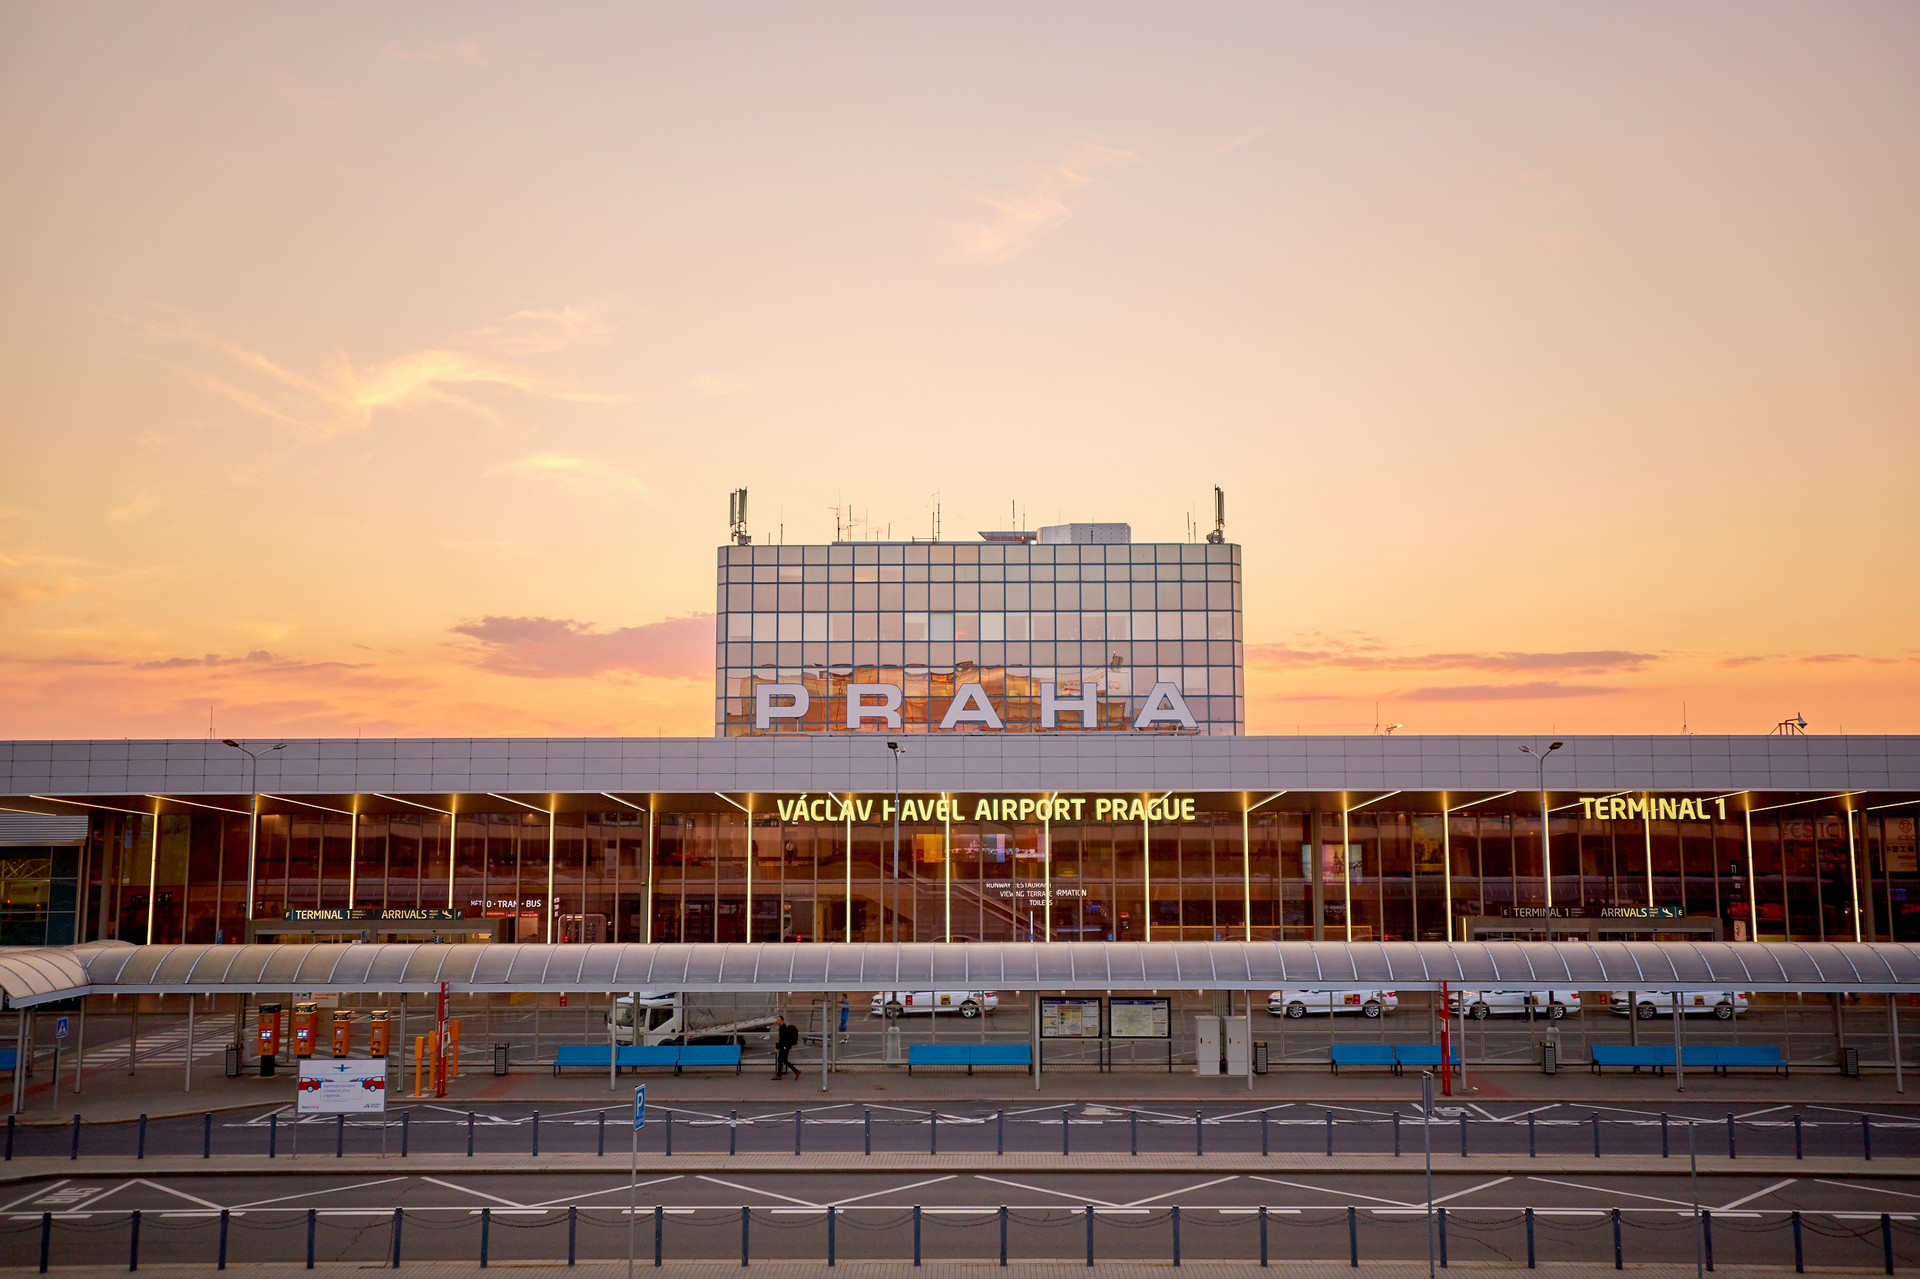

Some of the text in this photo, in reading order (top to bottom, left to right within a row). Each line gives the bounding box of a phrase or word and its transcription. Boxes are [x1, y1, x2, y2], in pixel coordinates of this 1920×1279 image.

[755, 682, 1198, 729] PRAHA
[777, 795, 1196, 821] VÁCLAV HAVEL AIRPORT PRAGUE
[1580, 797, 1726, 820] TERMINAL 1
[1000, 890, 1053, 898] VIEWNG TERRAE
[525, 899, 542, 908] BUS
[296, 910, 343, 920] TERMINAL
[346, 910, 351, 919] 1
[381, 909, 427, 919] ARRIVALS
[1564, 907, 1569, 917] 1
[1601, 907, 1648, 918] ARRIVALS
[636, 1091, 644, 1117] P
